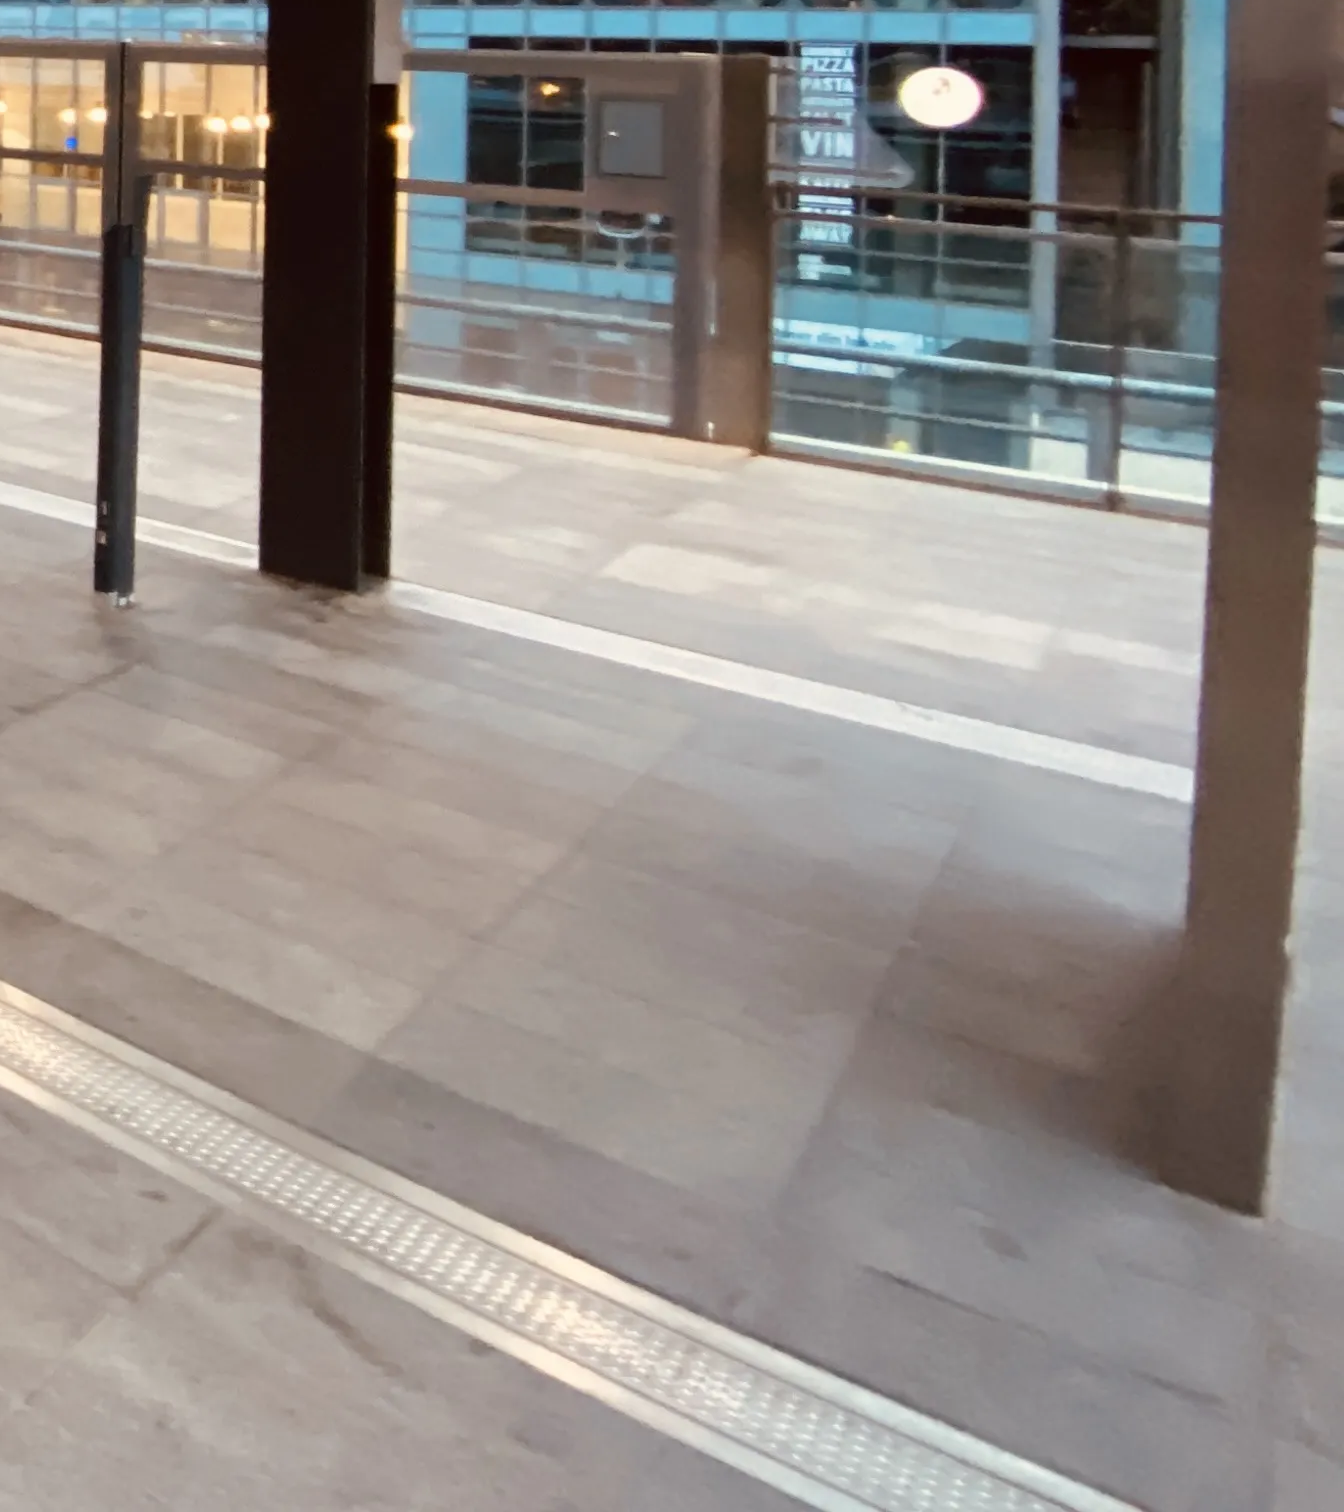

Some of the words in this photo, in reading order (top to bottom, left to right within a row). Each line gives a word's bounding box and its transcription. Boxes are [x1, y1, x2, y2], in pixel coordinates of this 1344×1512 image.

[800, 57, 855, 73] PIZZA
[799, 77, 855, 93] PASTA
[799, 129, 855, 159] VIN
